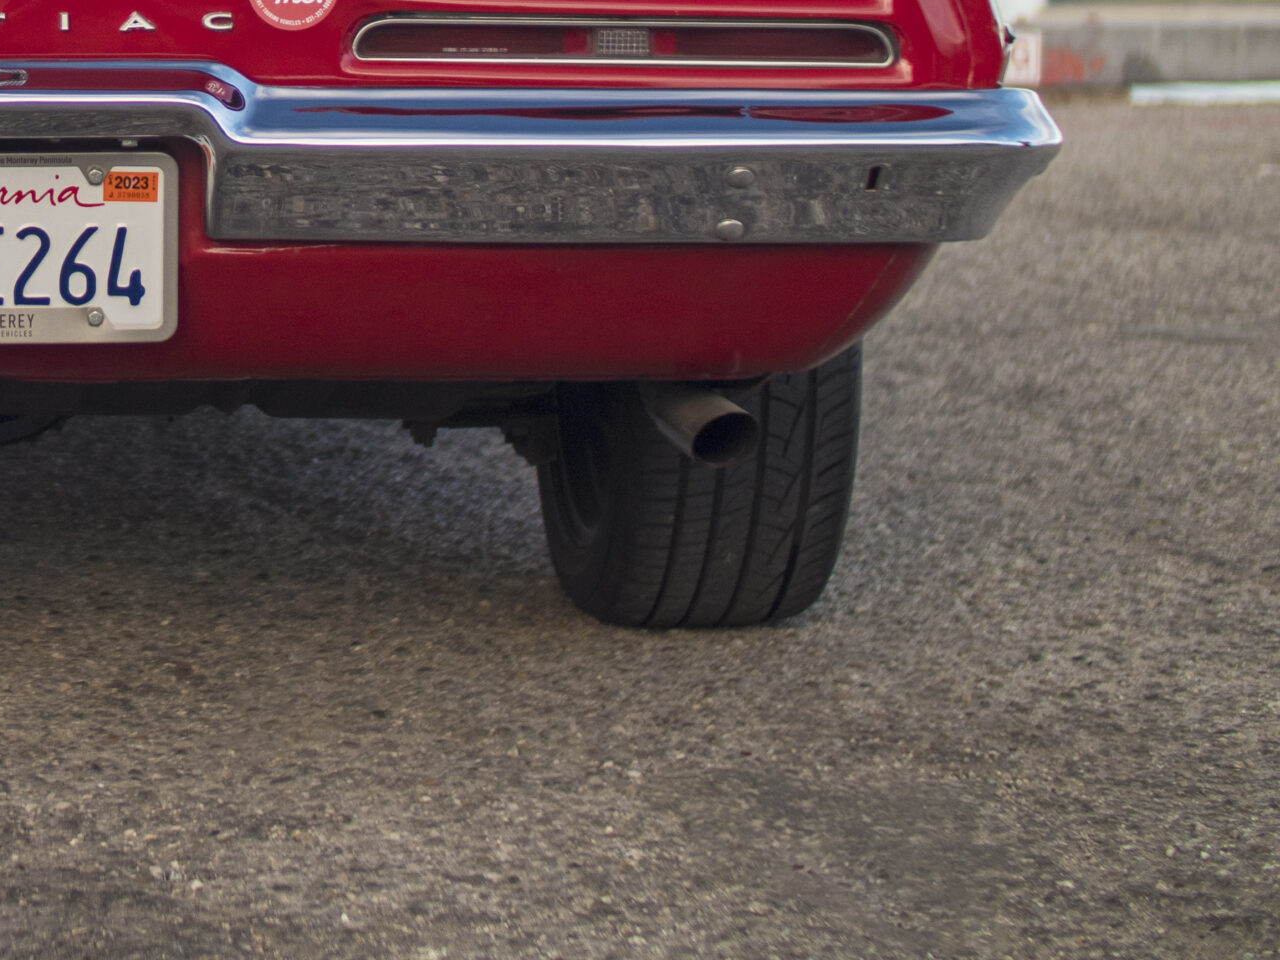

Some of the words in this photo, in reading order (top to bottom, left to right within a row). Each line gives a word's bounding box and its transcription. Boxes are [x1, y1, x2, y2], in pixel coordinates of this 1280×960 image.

[6, 156, 38, 166] Monterey
[39, 156, 72, 165] Peninsula
[114, 176, 149, 190] 2023
